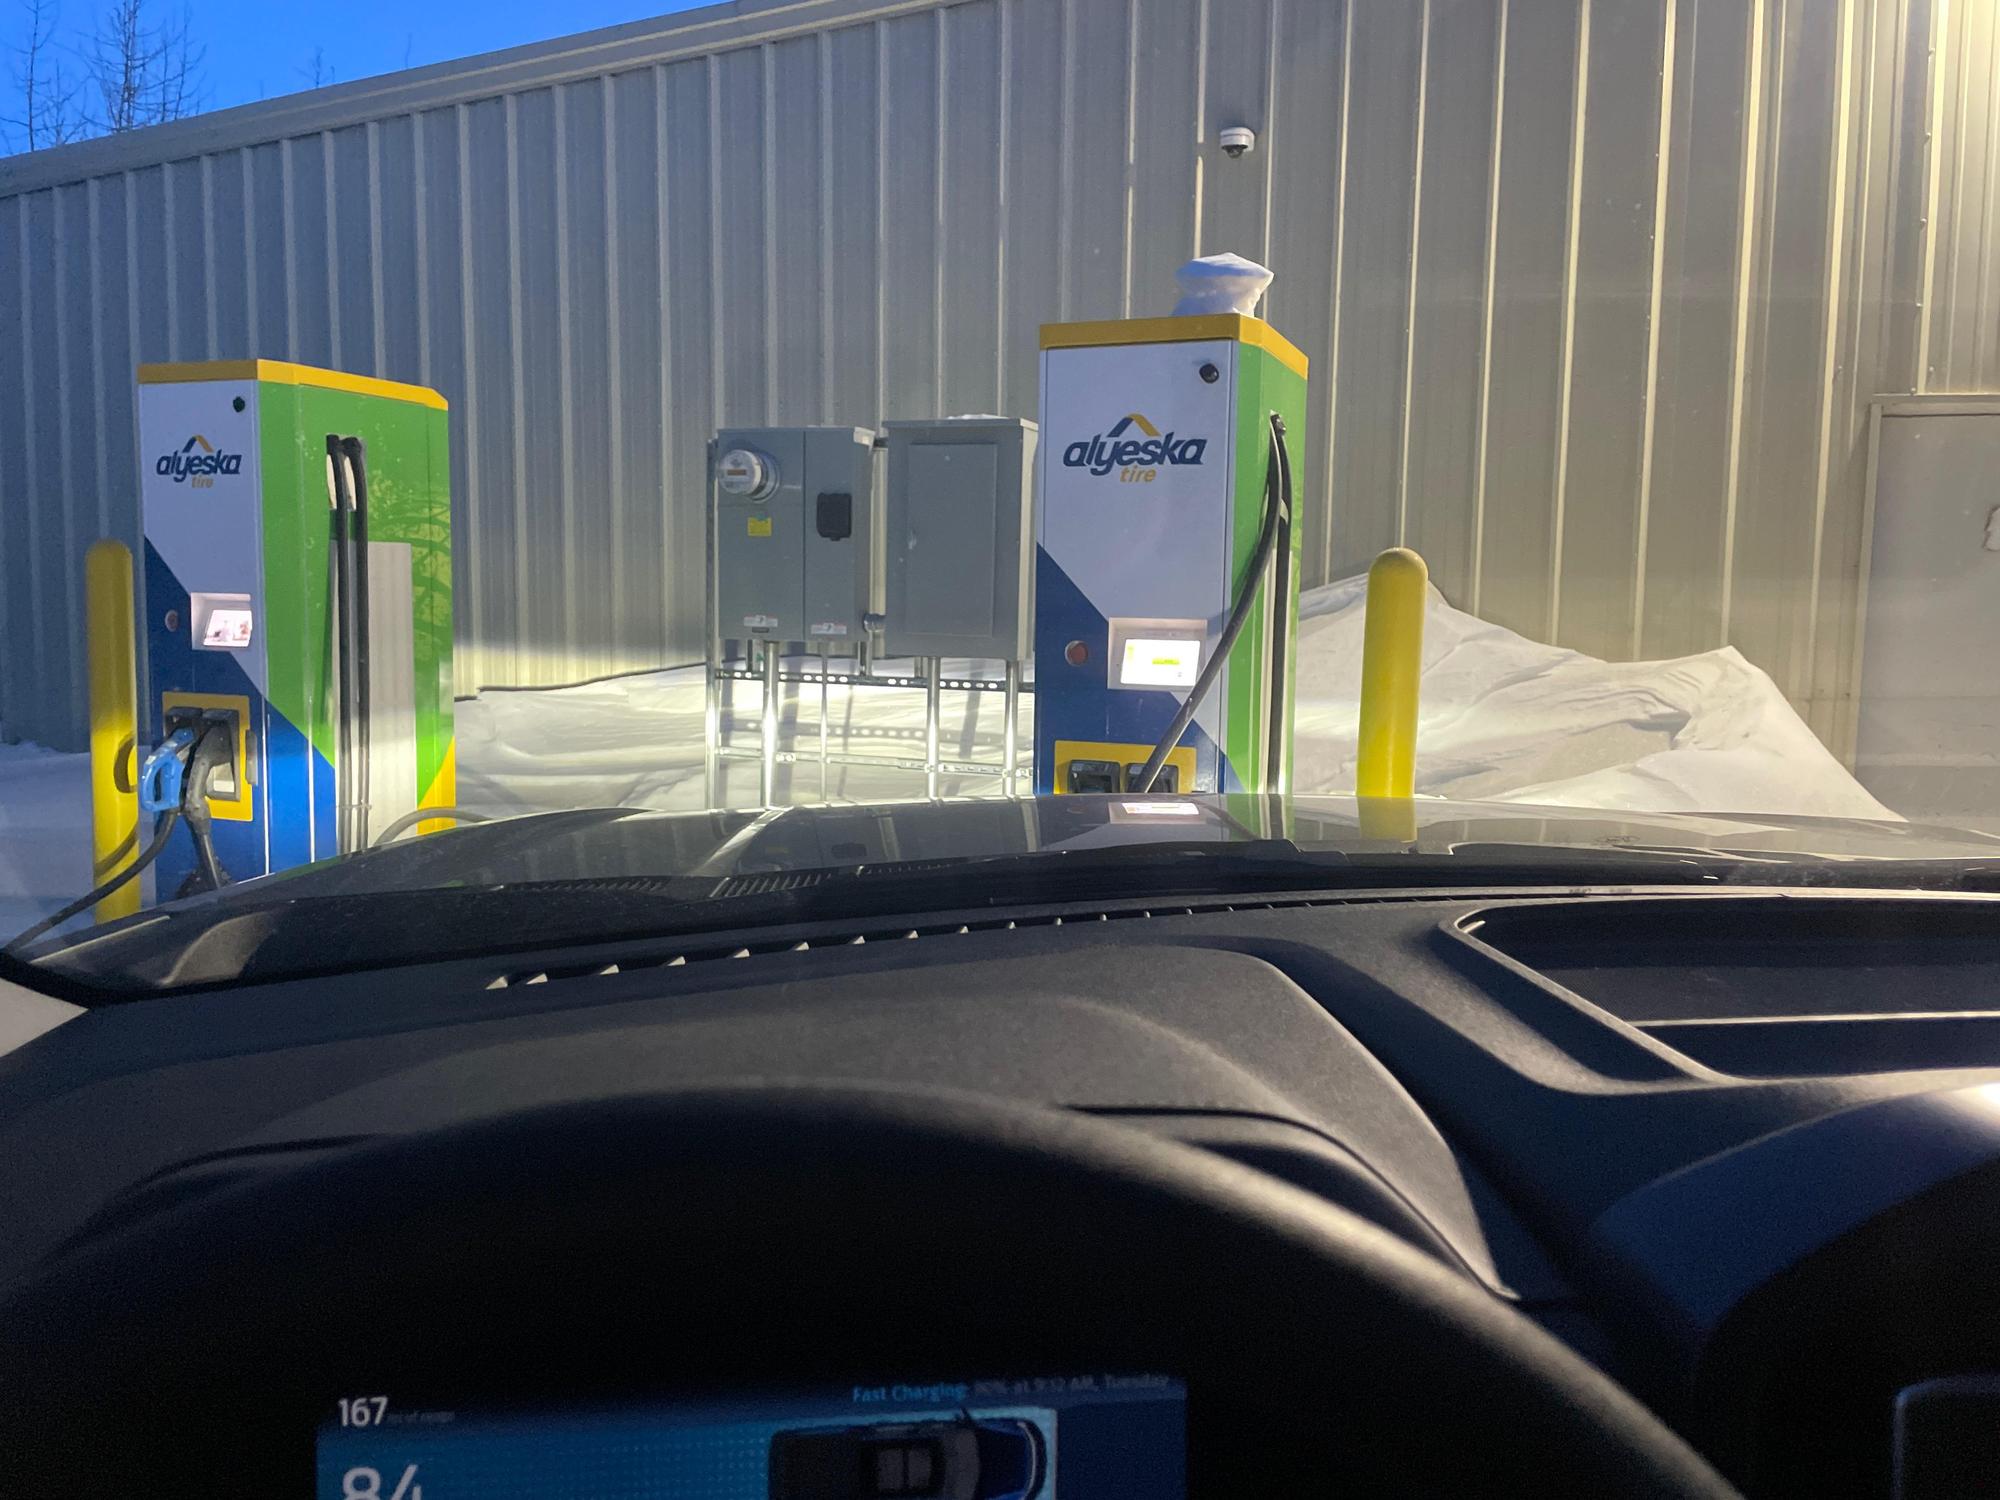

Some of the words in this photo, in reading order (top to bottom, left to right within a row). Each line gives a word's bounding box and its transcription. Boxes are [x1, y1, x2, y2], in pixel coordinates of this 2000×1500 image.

[156, 449, 243, 483] alyeska
[1063, 431, 1208, 477] alyeska
[1119, 465, 1157, 483] tire
[852, 1385, 886, 1402] Fast
[338, 1395, 388, 1428] 167
